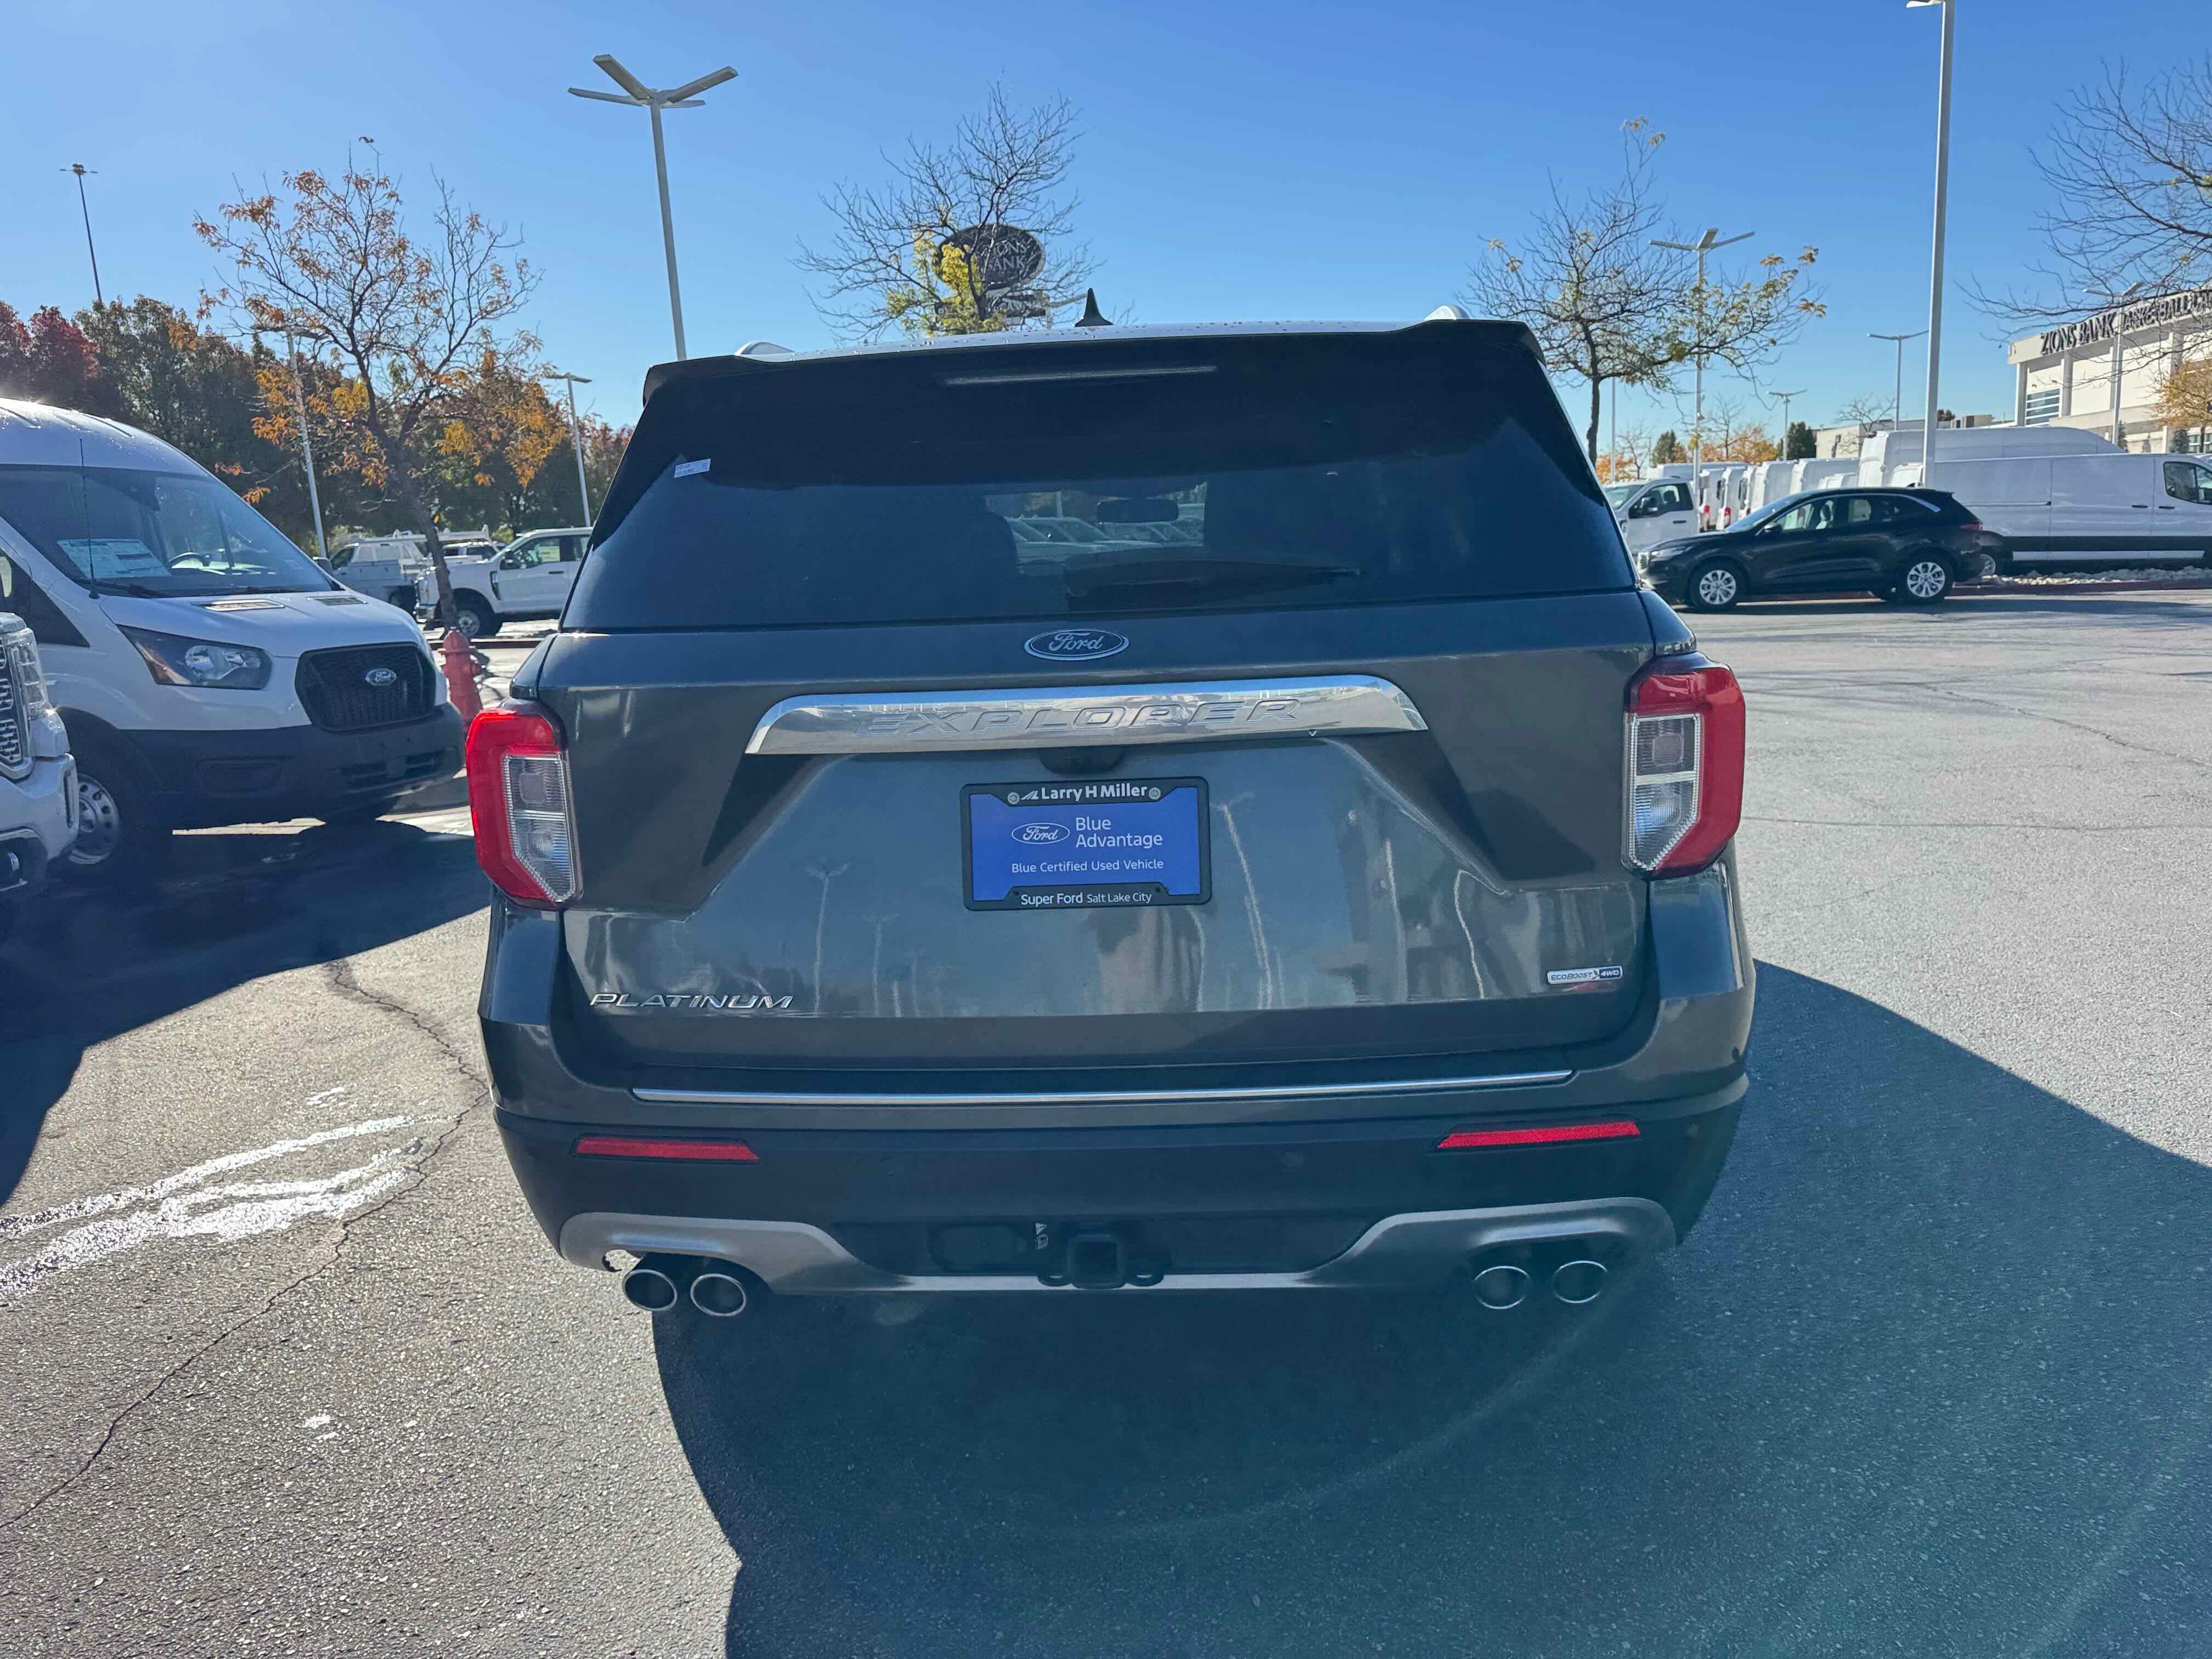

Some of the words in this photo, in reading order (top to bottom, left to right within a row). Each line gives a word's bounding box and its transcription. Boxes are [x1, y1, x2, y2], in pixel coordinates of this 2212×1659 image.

[2040, 325, 2078, 356] ZIONS
[2079, 312, 2117, 345] BANK
[1048, 631, 1104, 652] Ford
[853, 698, 1302, 737] EXPLORER
[1041, 787, 1081, 802] Larry
[1085, 786, 1097, 798] H
[1100, 784, 1148, 798] Miller
[1075, 816, 1111, 831] Blue
[1022, 825, 1059, 842] Ford
[1075, 833, 1163, 849] Advantage
[1012, 862, 1036, 873] Blue
[1040, 860, 1087, 872] Certified
[1091, 860, 1120, 871] Used
[1123, 859, 1164, 870] Vehicle
[1020, 894, 1055, 907] Super
[1057, 892, 1083, 904] Ford
[1087, 893, 1106, 903] Salt
[1107, 892, 1131, 902] Lake
[1132, 891, 1152, 904] City
[1550, 972, 1593, 981] ECOBOOST
[1600, 969, 1620, 977] 4WD
[589, 993, 795, 1009] PLATINUM
